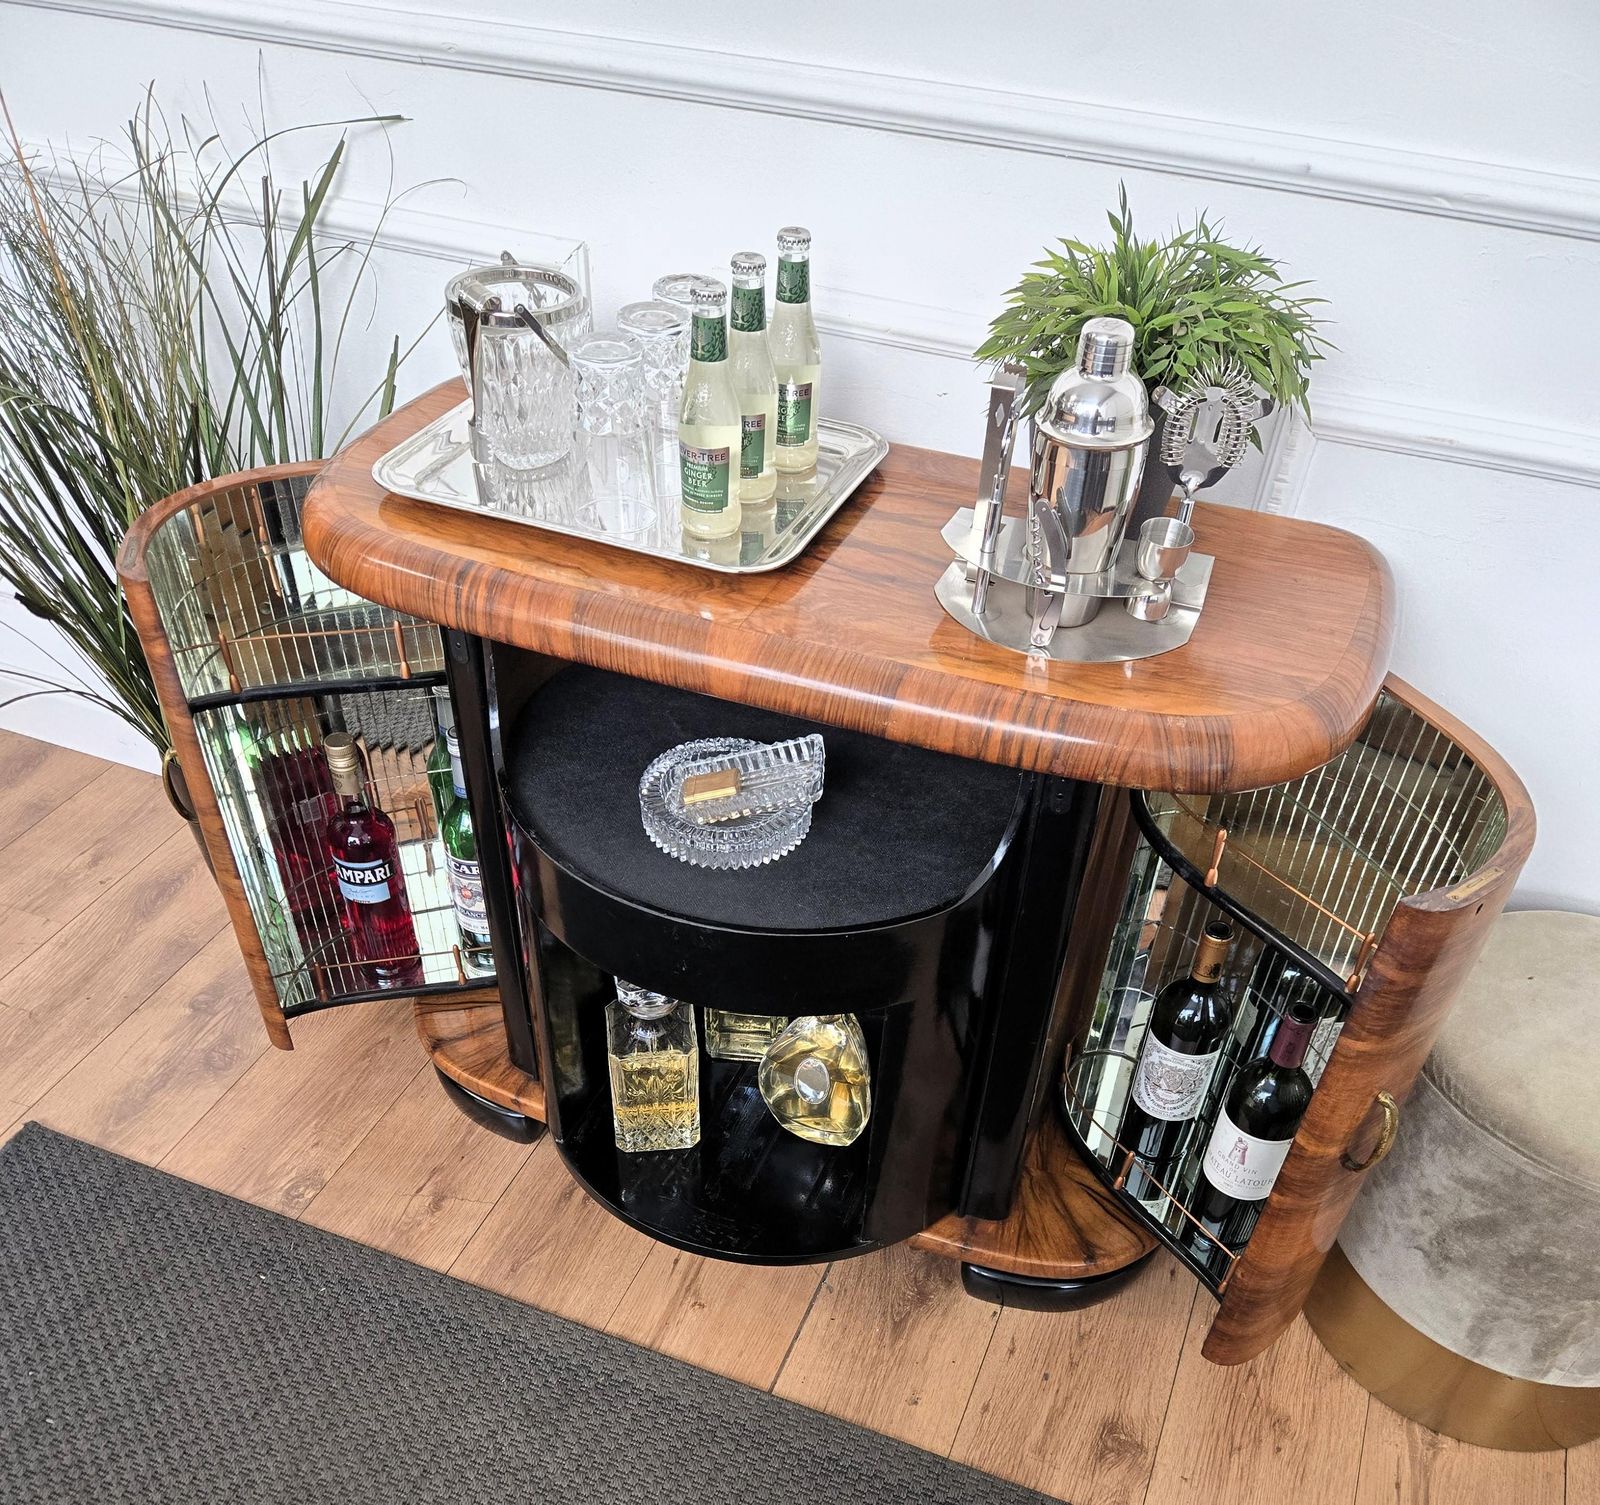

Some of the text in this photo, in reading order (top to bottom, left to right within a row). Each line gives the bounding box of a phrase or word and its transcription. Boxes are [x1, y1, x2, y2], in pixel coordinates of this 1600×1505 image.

[684, 467, 713, 480] GINGER
[688, 476, 707, 488] BEER
[1217, 1150, 1257, 1175] GRAND VIN
